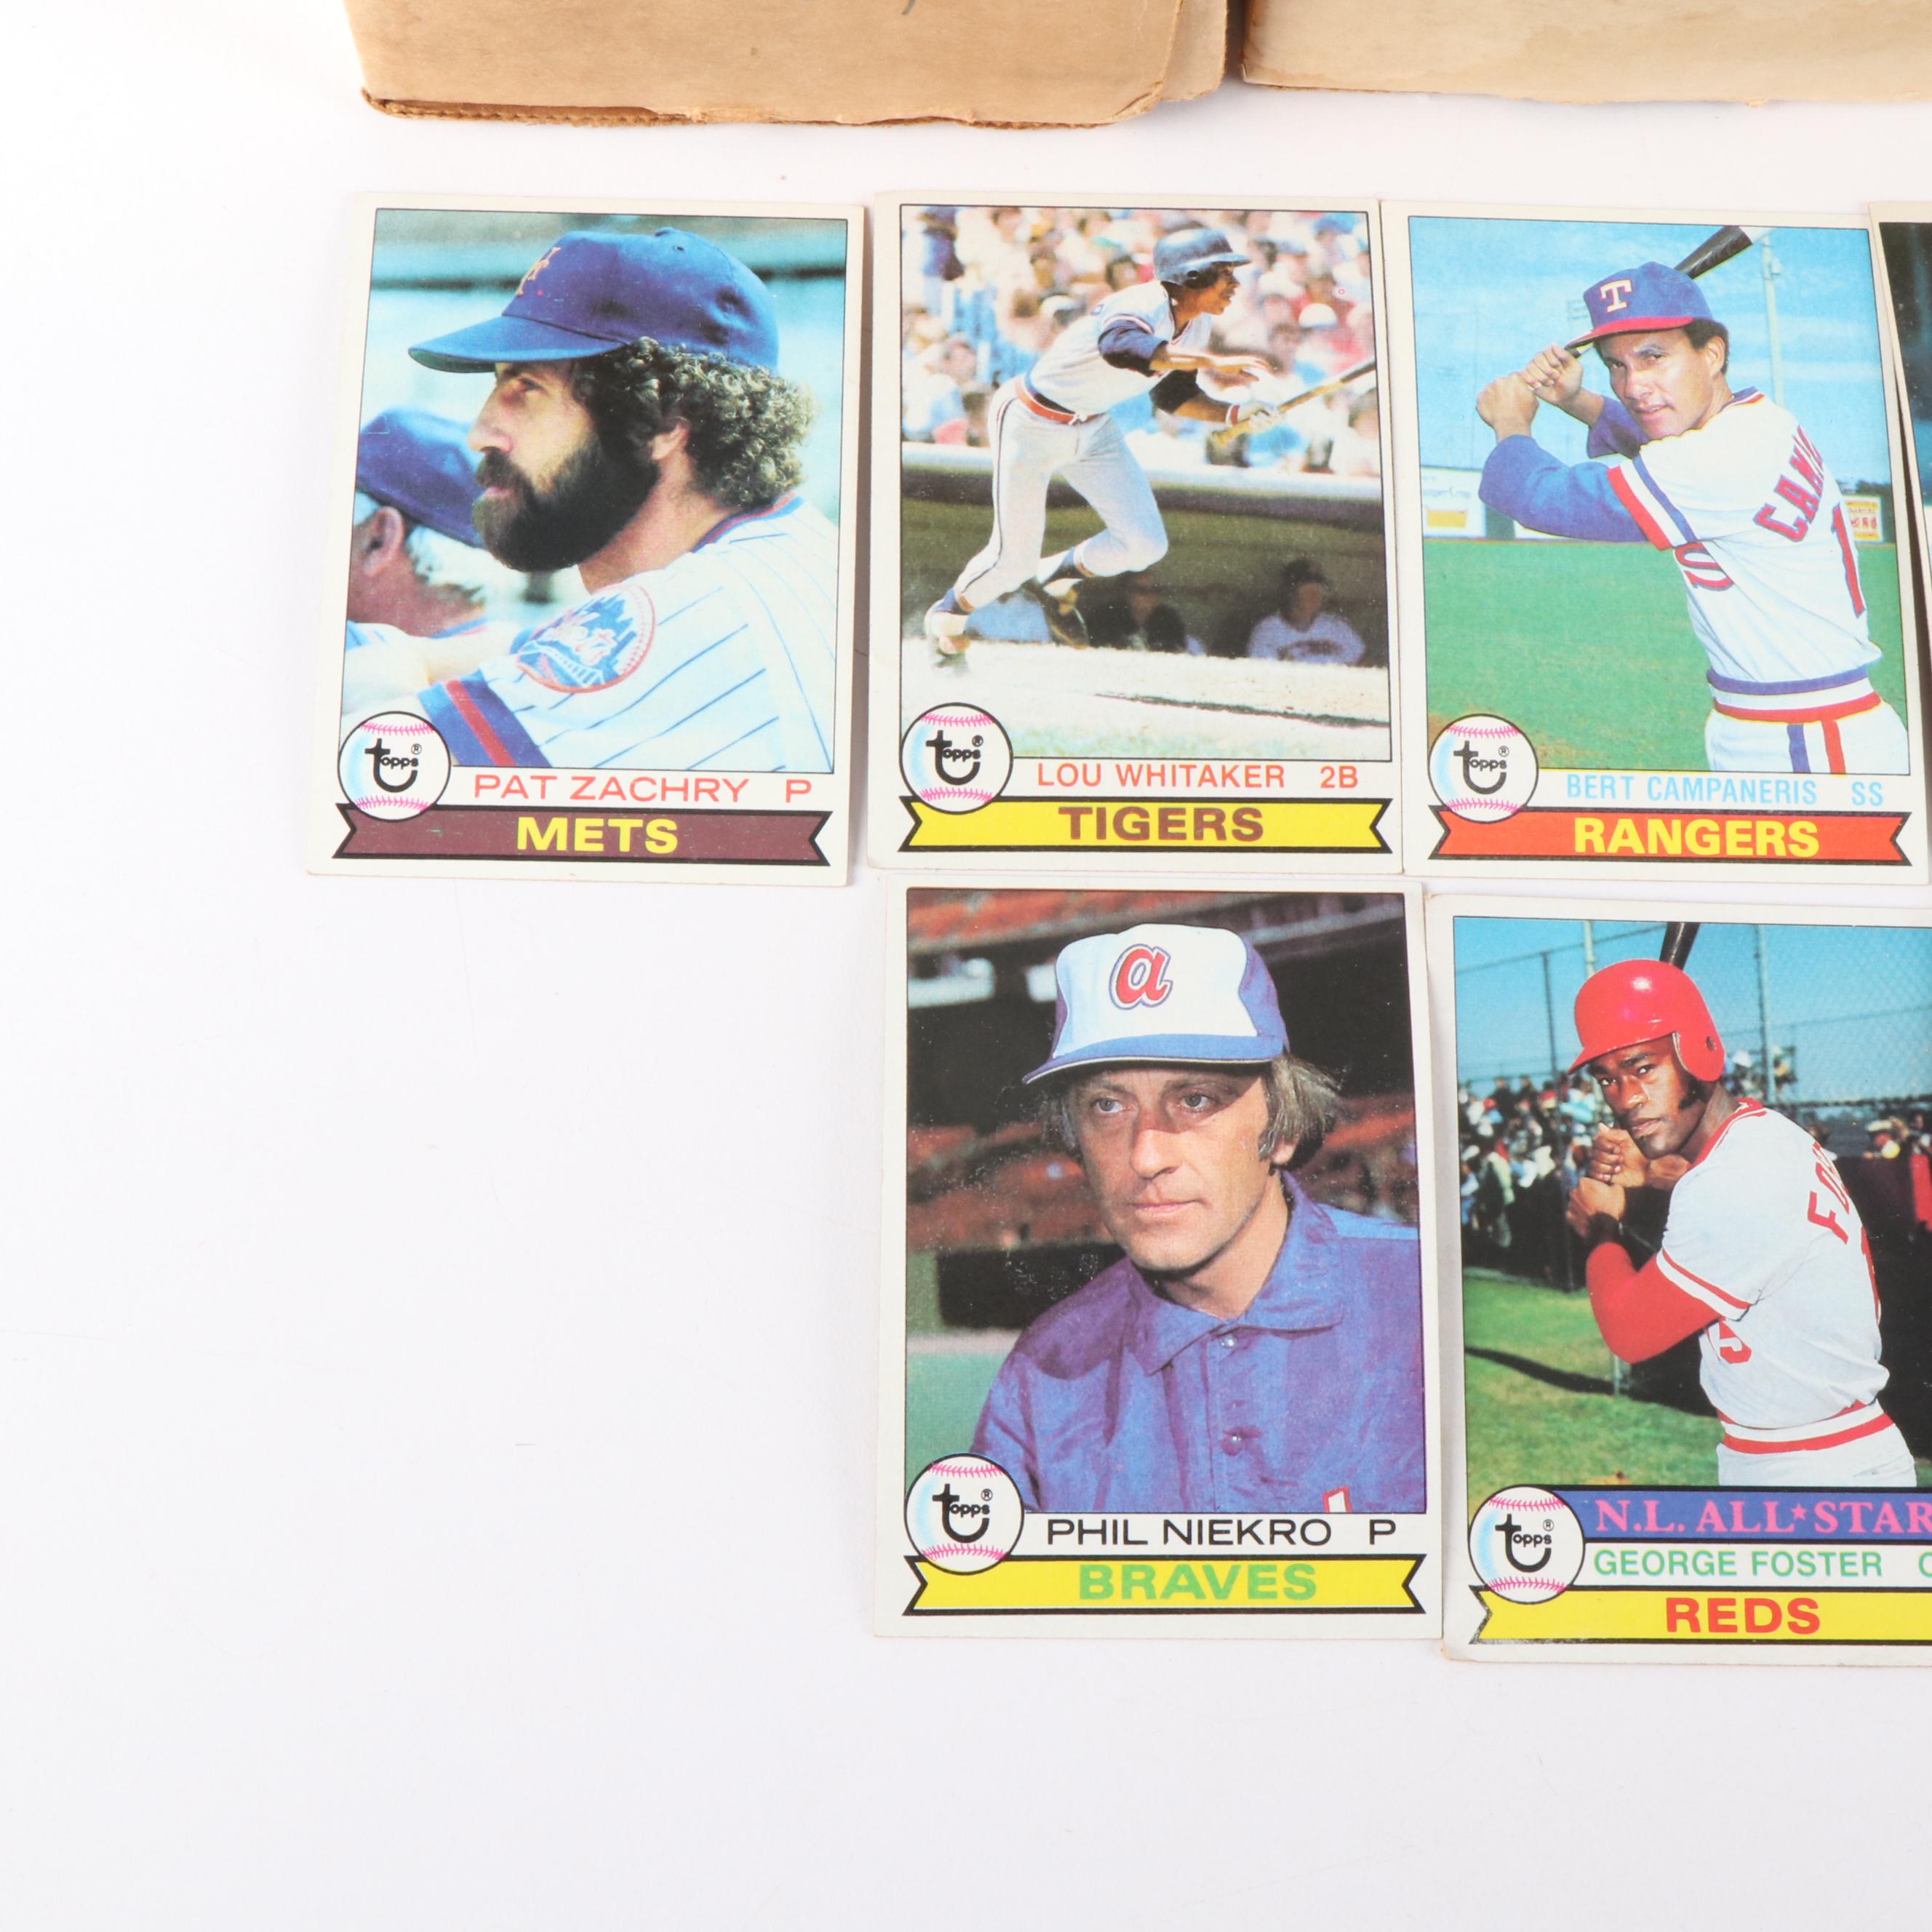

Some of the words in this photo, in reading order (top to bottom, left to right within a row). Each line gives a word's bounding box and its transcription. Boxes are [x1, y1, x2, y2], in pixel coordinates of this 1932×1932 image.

[364, 738, 419, 793] topps
[925, 730, 981, 786] topps
[1037, 762, 1101, 787] LOU
[1115, 763, 1285, 789] WHITAKER
[1320, 765, 1358, 789] 2B
[1453, 741, 1507, 794] topps
[474, 774, 557, 799] PAT
[570, 776, 749, 802] ZACHRY
[786, 779, 812, 803] P
[1568, 774, 1634, 800] BERT
[1647, 776, 1818, 805] CAMPANERIS
[1851, 781, 1884, 807] SS
[516, 817, 678, 854] METS
[1058, 806, 1264, 842] TIGERS
[1575, 818, 1820, 858] RANGERS
[932, 1483, 991, 1544] topps
[1595, 1500, 1685, 1533] N.L.
[1047, 1519, 1149, 1546] PHIL
[1164, 1519, 1332, 1546] NIEKRO
[1369, 1519, 1397, 1546] P
[1495, 1513, 1552, 1573] topps
[1080, 1563, 1317, 1600] BRAVES
[1594, 1548, 1737, 1577] GEORGE
[1752, 1550, 1883, 1578] FOSTER
[1666, 1597, 1821, 1635] REDS
